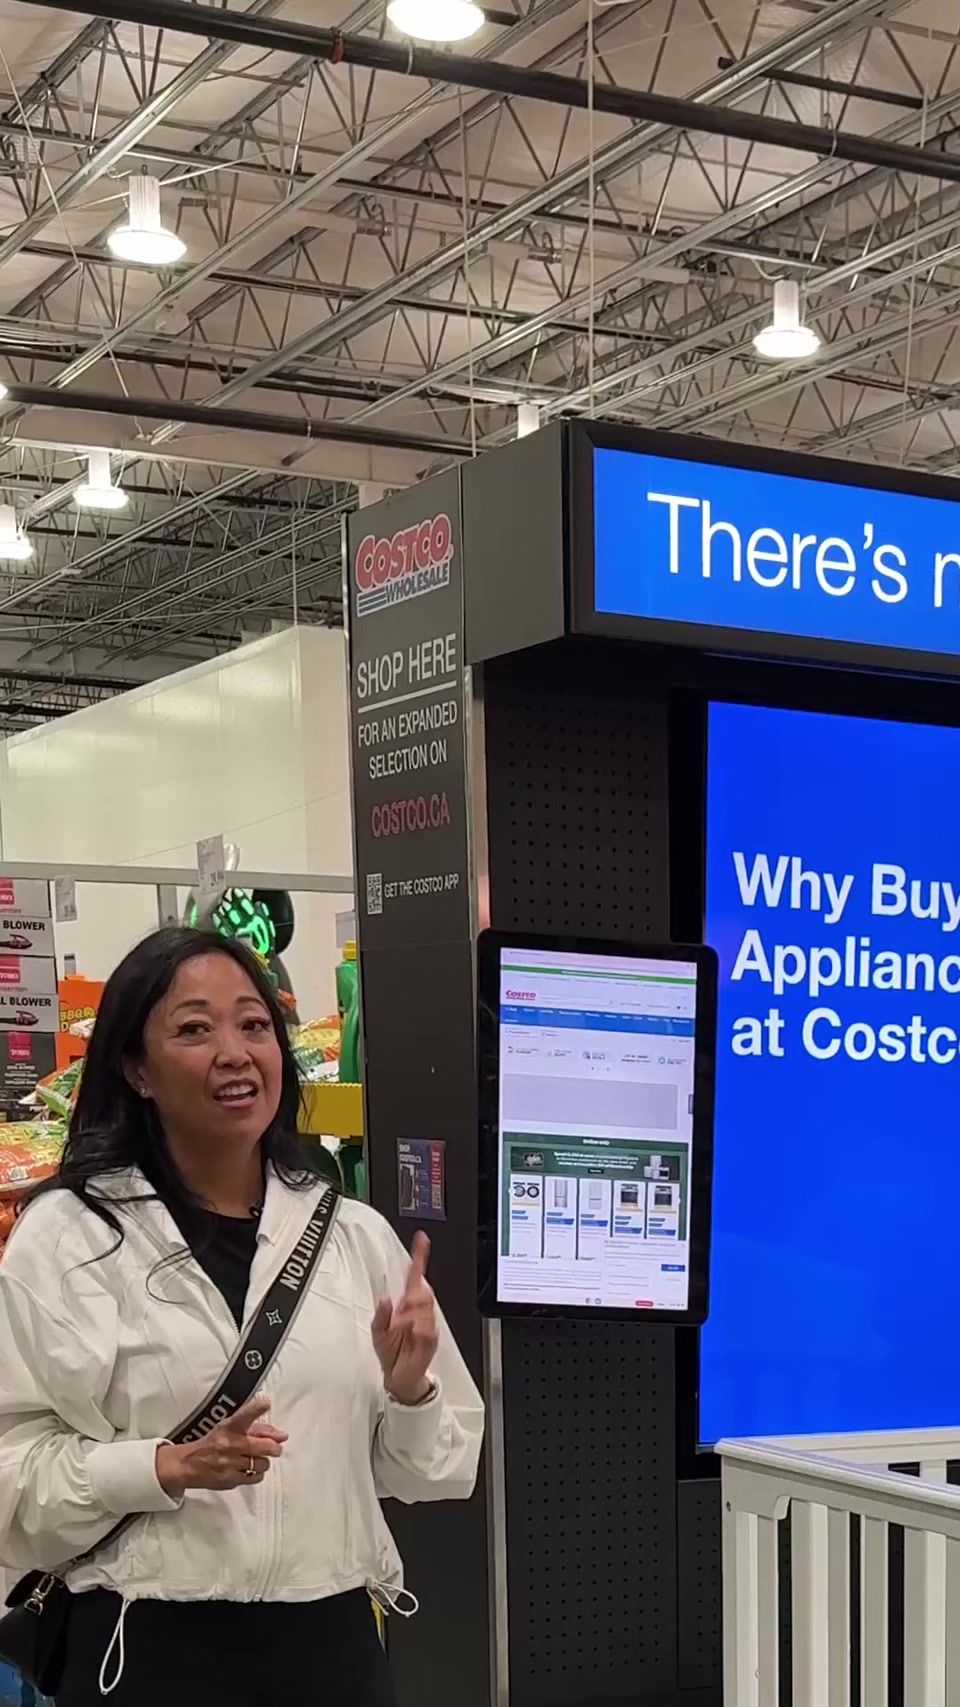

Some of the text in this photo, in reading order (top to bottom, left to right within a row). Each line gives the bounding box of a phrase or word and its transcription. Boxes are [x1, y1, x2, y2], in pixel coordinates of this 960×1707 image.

[355, 513, 452, 592] COSTCO
[645, 491, 909, 604] There's
[385, 562, 450, 604] WHOLESALE
[357, 633, 457, 698] SHOP HERE
[358, 701, 458, 748] FOR AN EXPANDED
[369, 738, 448, 780] SELECTION ON
[371, 792, 451, 838] COSTCO.CA
[384, 873, 459, 898] GET THE COSTCO APP
[731, 851, 855, 925] Why
[2, 920, 46, 932] BLOWER
[9, 996, 52, 1008] BLOWER
[505, 989, 537, 999] COSTCO
[731, 1008, 785, 1057] at
